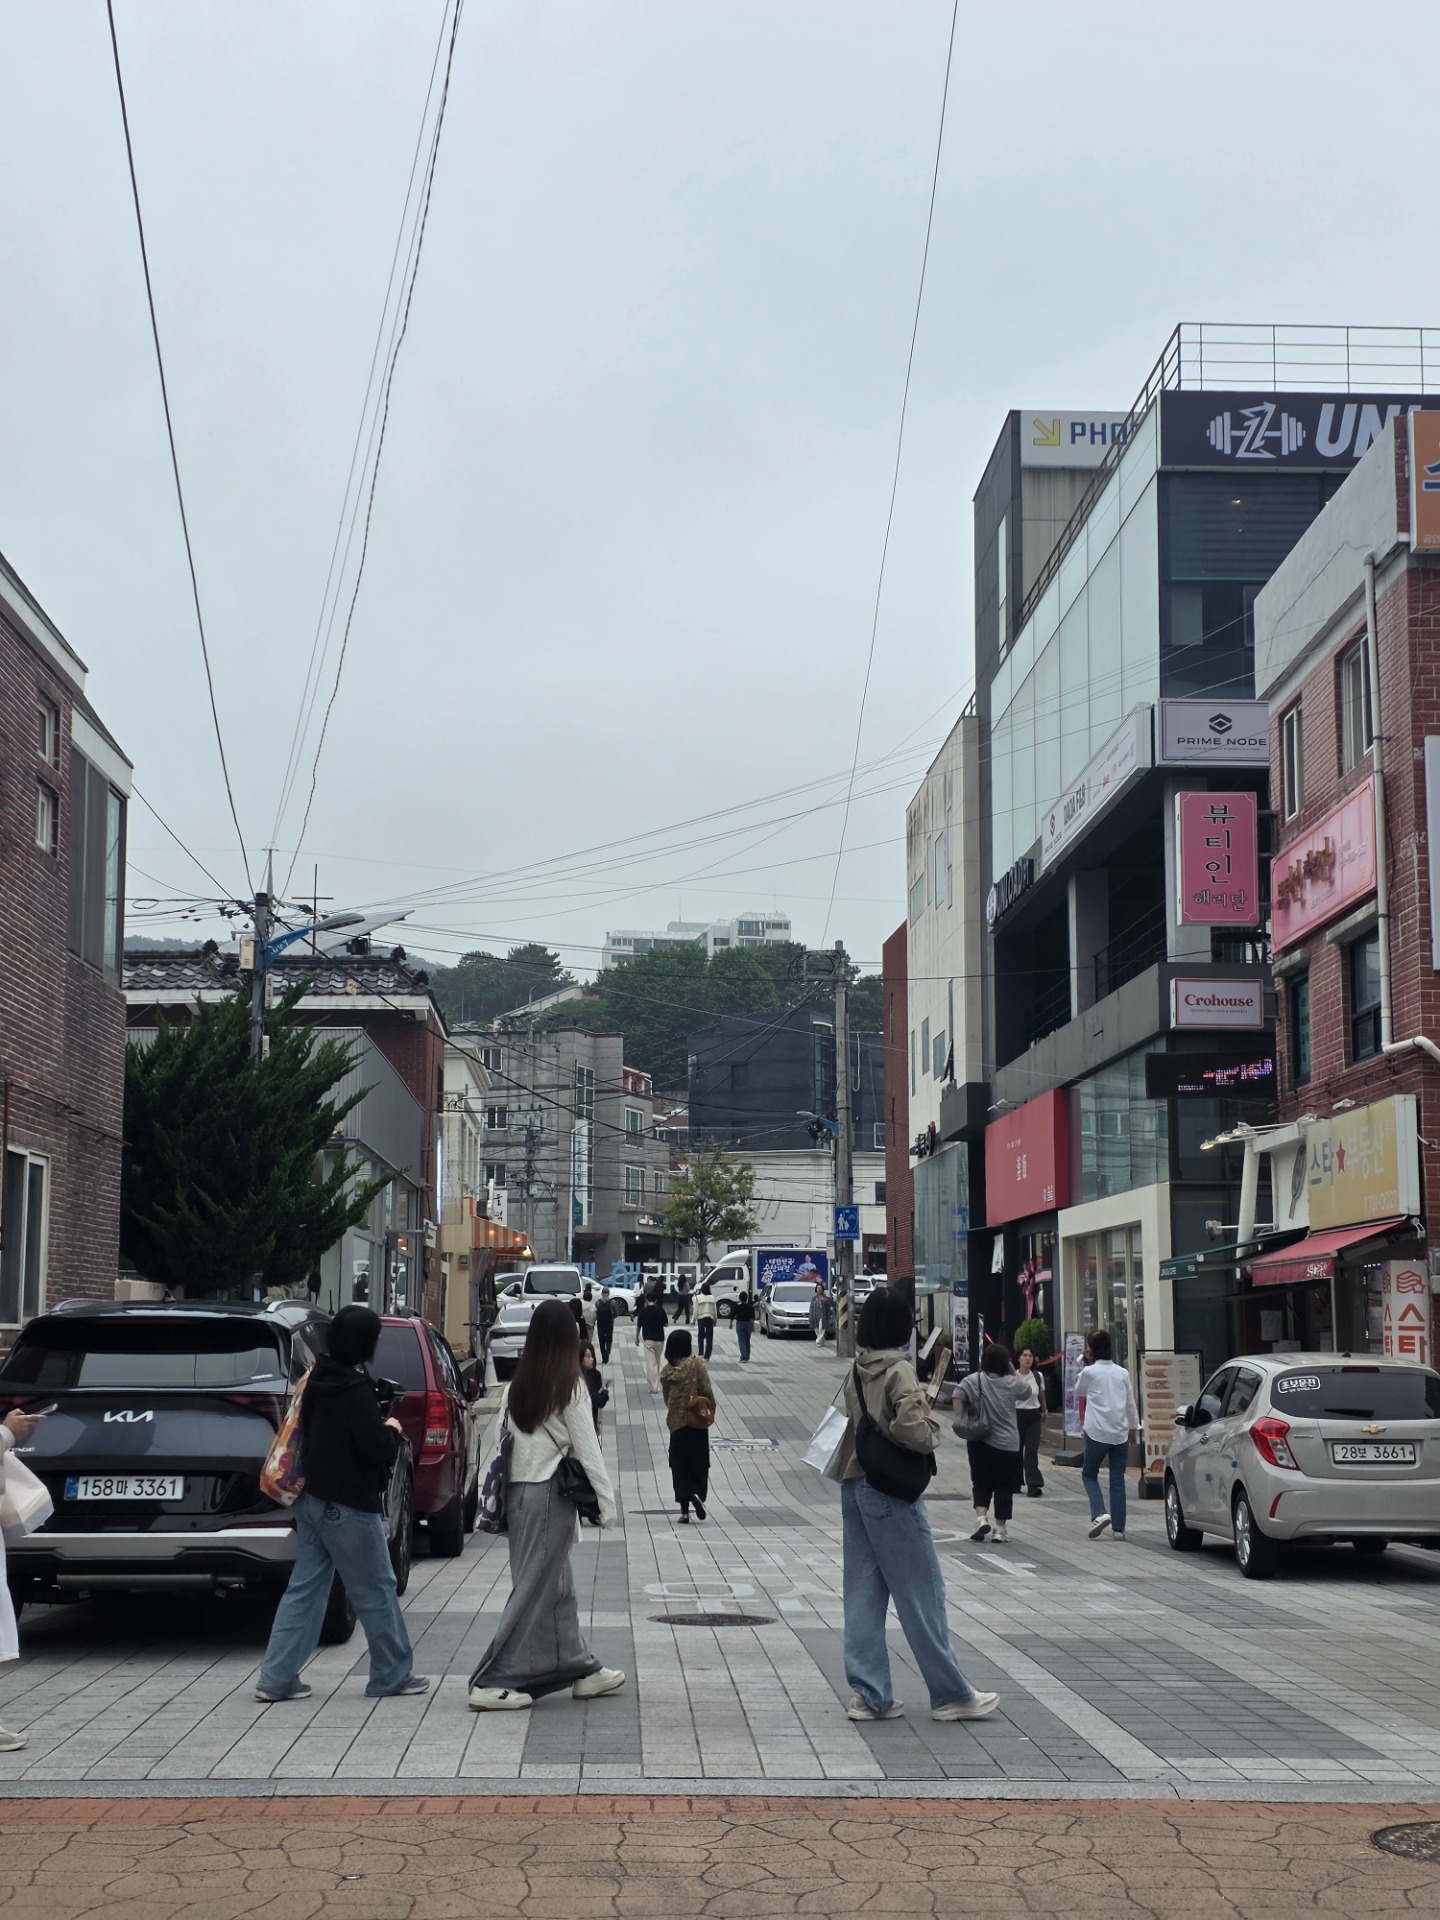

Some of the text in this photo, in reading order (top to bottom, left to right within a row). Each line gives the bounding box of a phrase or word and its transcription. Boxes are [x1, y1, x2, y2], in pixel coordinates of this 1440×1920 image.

[1315, 402, 1422, 458] UN
[1177, 737, 1267, 746] PRIME NODE
[1202, 804, 1237, 884] 뷰티인
[1193, 889, 1247, 911] 해리단
[1184, 993, 1254, 1007] Crohouse
[1310, 1136, 1334, 1186] 스타
[1397, 1302, 1427, 1362] 스타
[1281, 1378, 1316, 1390] 초보운전
[103, 1410, 154, 1423] KIA
[1341, 1446, 1406, 1459] 28보 3661
[81, 1478, 177, 1497] 158마 3361
